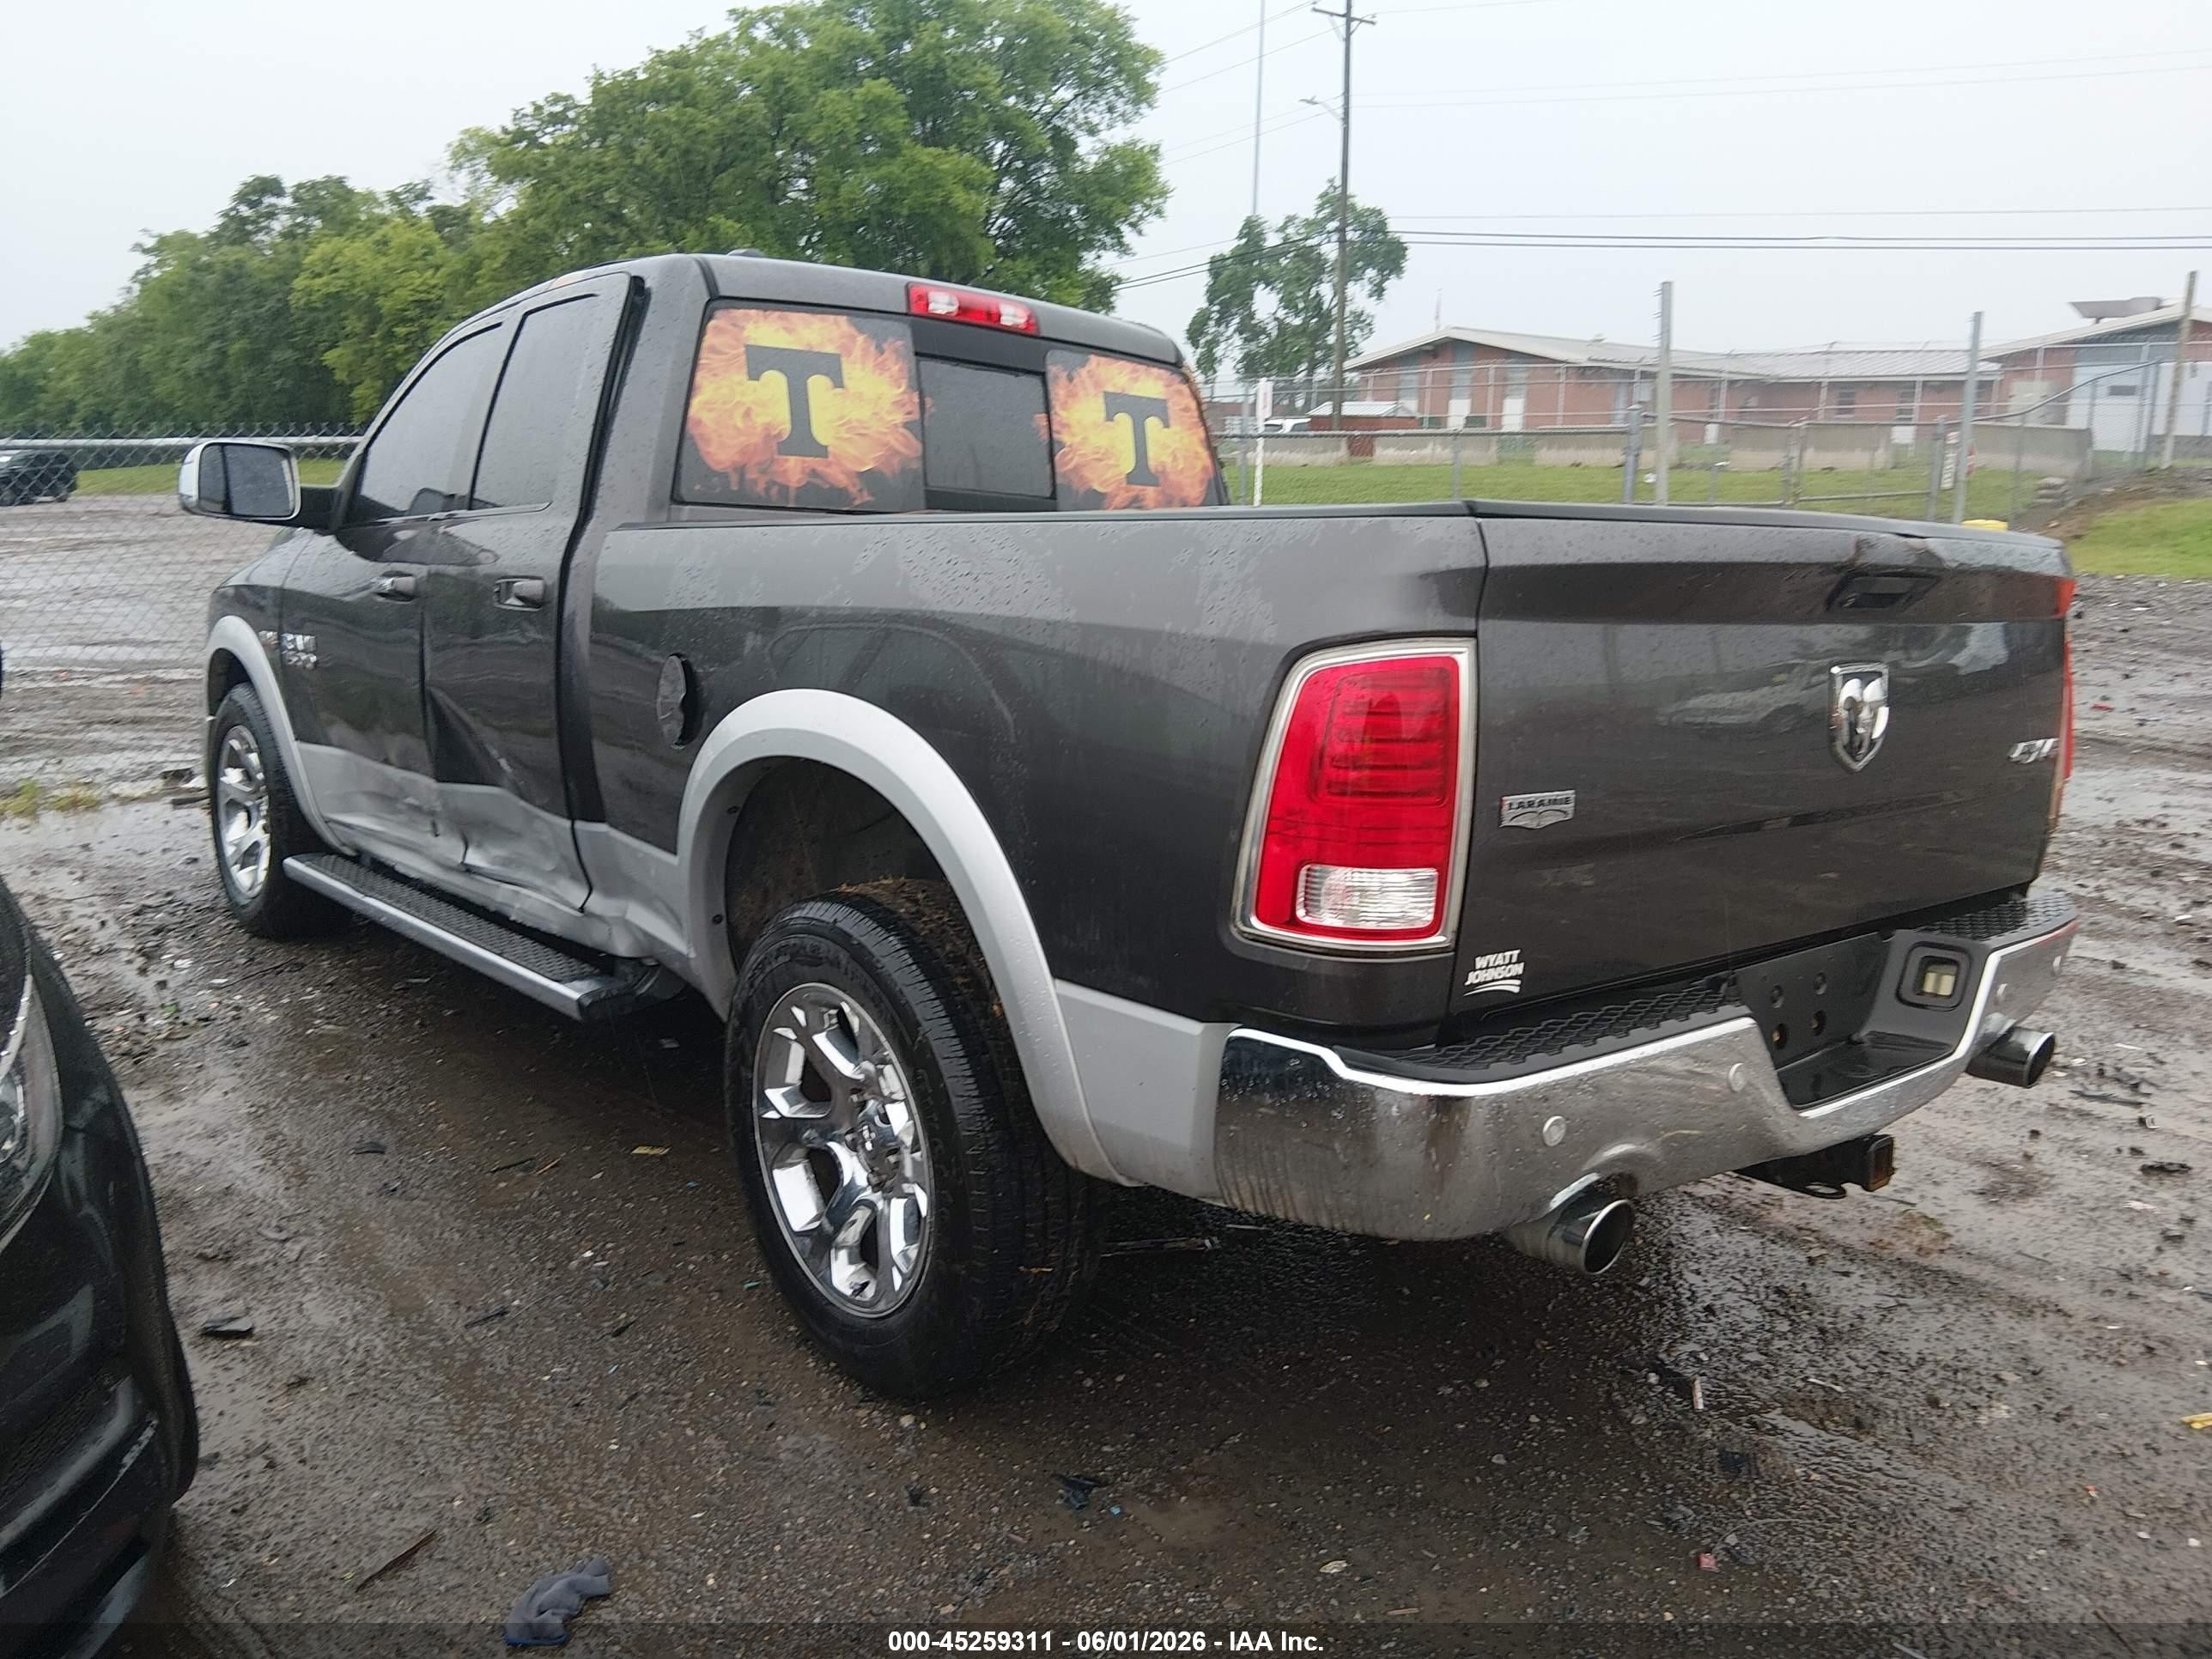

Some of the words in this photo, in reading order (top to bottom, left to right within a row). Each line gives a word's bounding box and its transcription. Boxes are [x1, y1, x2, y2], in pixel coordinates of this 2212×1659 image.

[744, 343, 845, 459] T
[1103, 391, 1170, 487] T
[1508, 796, 1571, 811] LARAMIE
[1475, 949, 1521, 969] WYATT
[1464, 962, 1525, 986] JOHNSON
